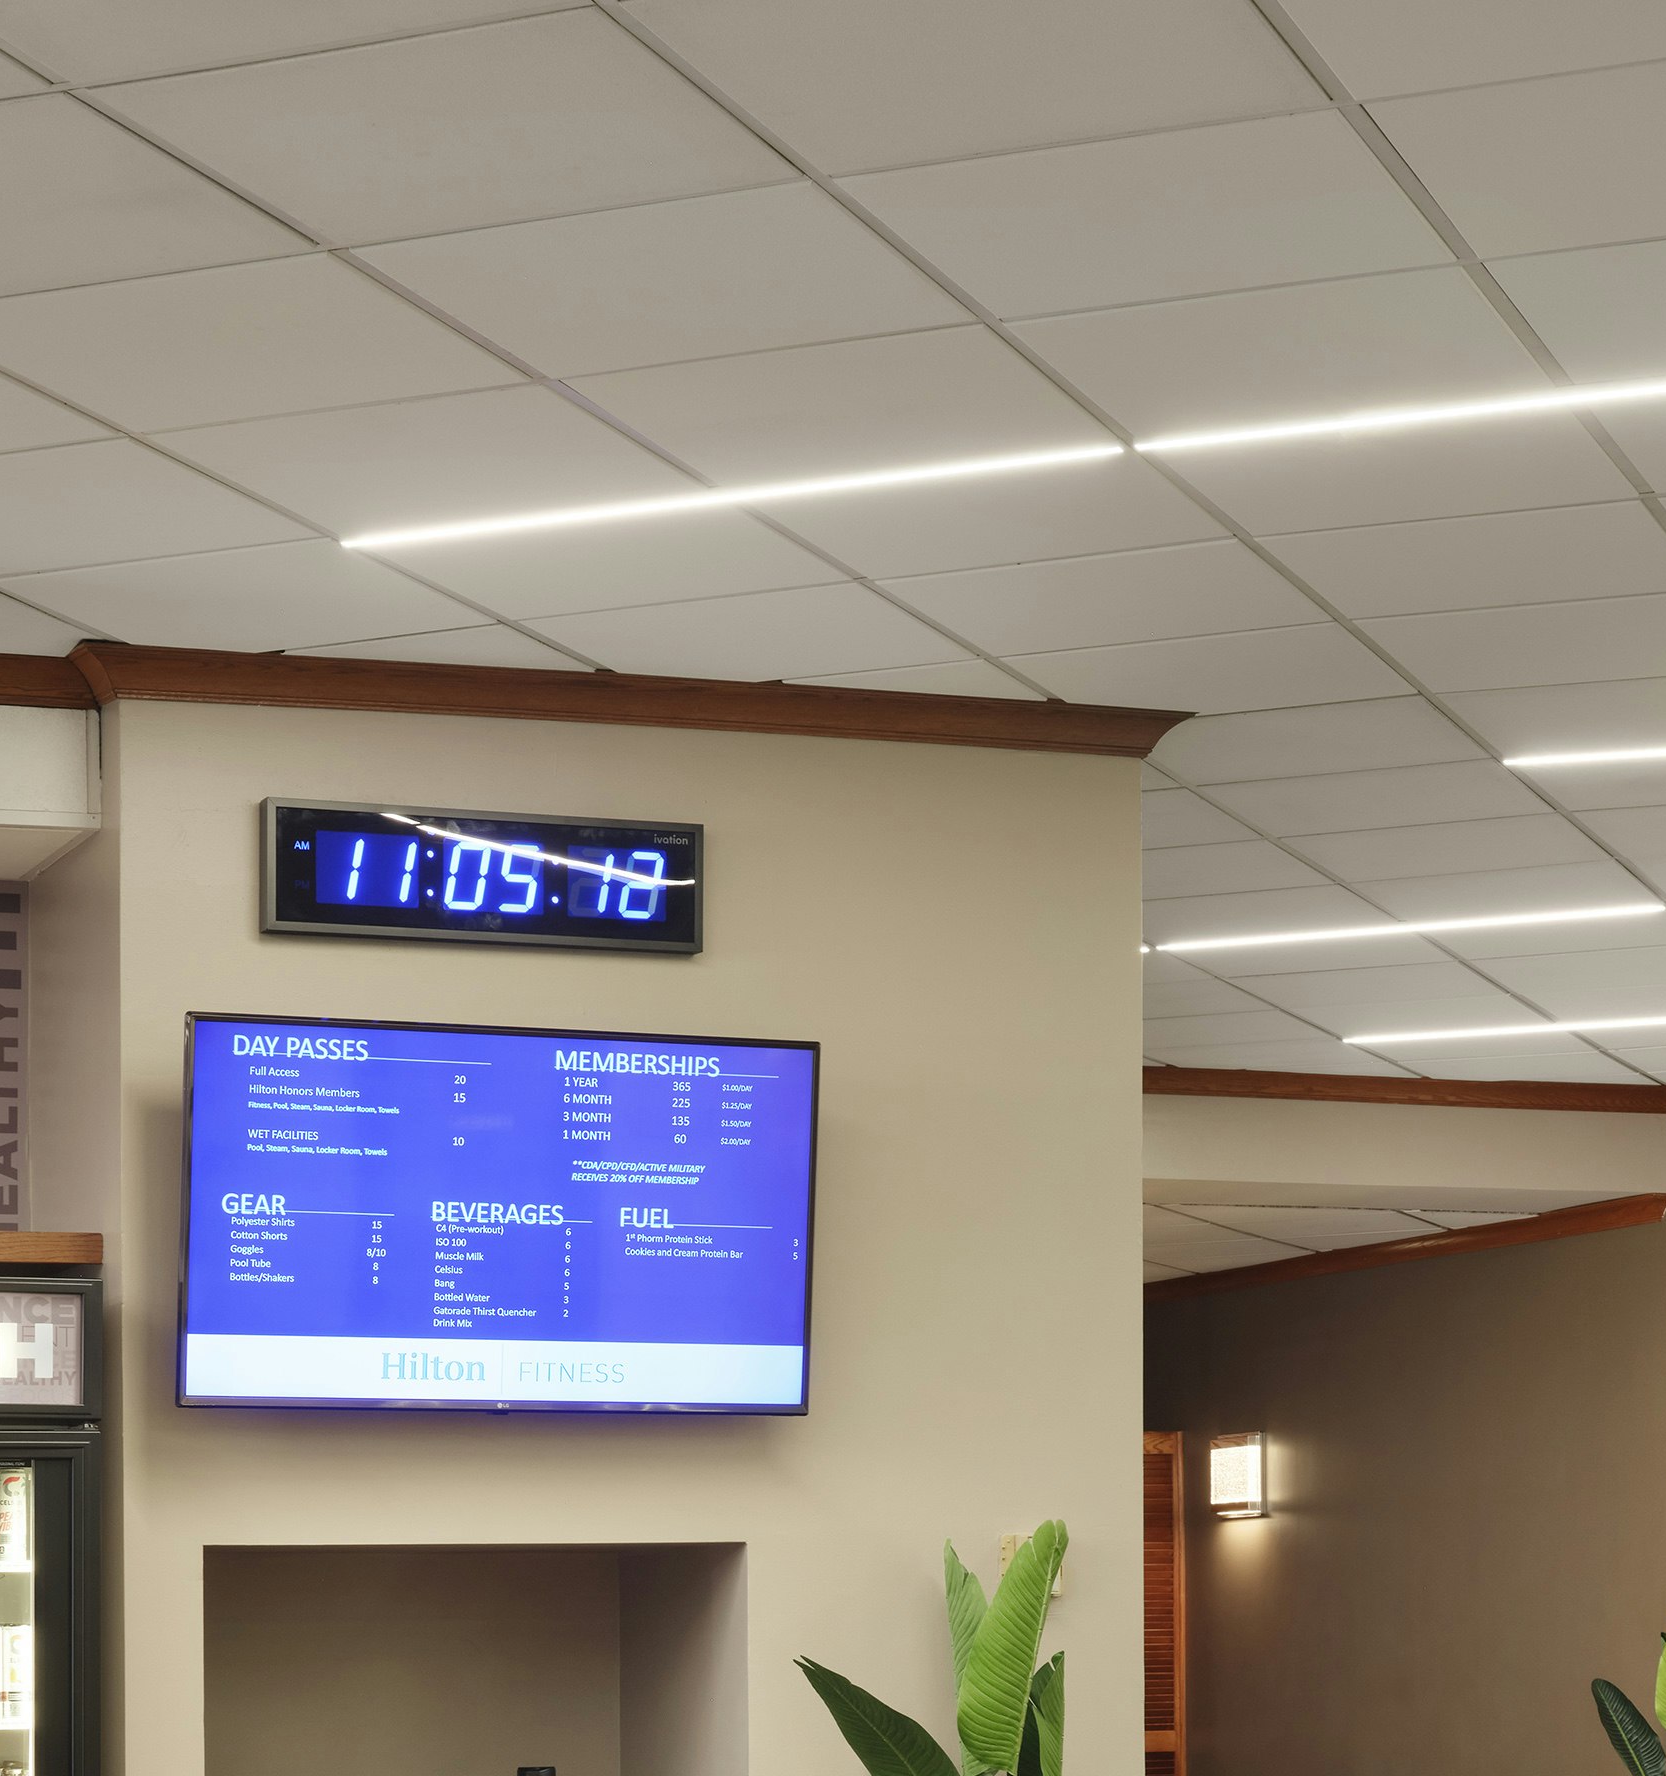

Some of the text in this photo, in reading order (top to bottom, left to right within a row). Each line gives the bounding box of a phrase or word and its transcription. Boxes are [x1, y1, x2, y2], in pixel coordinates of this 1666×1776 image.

[653, 834, 689, 846] ivation
[293, 840, 310, 851] AM
[233, 1035, 369, 1061] DAY PASSES
[555, 1050, 720, 1077] MEMBERSHIPS
[250, 1066, 299, 1077] Full Access
[454, 1075, 466, 1084] 20
[565, 1077, 598, 1087] 1 YEAR
[250, 1084, 360, 1098] Hilton Honors Members
[673, 1082, 691, 1091] 365
[454, 1093, 466, 1103] 15
[564, 1094, 611, 1104] 6 MONTH
[672, 1098, 690, 1108] 225
[274, 1102, 289, 1110] Pool,
[291, 1103, 312, 1111] Steam,
[313, 1104, 334, 1112] Sauna,
[563, 1112, 611, 1122] 3 MONTH
[672, 1116, 689, 1126] 135
[248, 1129, 318, 1140] WET FACILITIES
[563, 1130, 610, 1140] 1 MONTH
[674, 1134, 686, 1144] 60
[453, 1137, 464, 1146] 10
[247, 1144, 264, 1152] Pool,
[266, 1145, 290, 1153] Steam,
[292, 1146, 315, 1154] Sauna,
[340, 1147, 362, 1155] Room,
[668, 1165, 705, 1173] MILITARY
[572, 1173, 699, 1184] RECEIVES 20% OFF MEMBERSHIP
[221, 1193, 286, 1215] GEAR
[432, 1200, 564, 1226] BEVERAGES
[620, 1207, 674, 1229] FUEL
[232, 1217, 295, 1226] Polyester Shirts
[372, 1221, 382, 1229] 15
[436, 1224, 503, 1235] C4 (Pre-workout)
[566, 1228, 571, 1236] 6
[231, 1231, 287, 1240] Cotton Shorts
[372, 1235, 381, 1243] 15
[637, 1234, 663, 1242] Phorm
[665, 1235, 692, 1243] Protein
[695, 1236, 712, 1244] Stick
[436, 1238, 466, 1246] ISO 100
[230, 1245, 264, 1255] Goggles
[367, 1248, 386, 1258] 8/10
[625, 1247, 743, 1258] Cookies and Cream Protein Bar
[436, 1252, 483, 1260] Muscle Milk
[565, 1255, 570, 1263] 6
[793, 1252, 798, 1260] 5
[231, 1259, 271, 1267] Pool Tube
[373, 1262, 378, 1270] 8
[435, 1265, 463, 1274] Celsius
[230, 1273, 294, 1282] Bottles/Shakers
[373, 1276, 378, 1284] 8
[435, 1279, 455, 1289] Bang
[564, 1282, 569, 1290] 5
[434, 1293, 490, 1302] Bottled Water
[434, 1307, 536, 1316] Gatorade Thirst Quencher
[434, 1319, 472, 1327] Drink Mix
[381, 1352, 625, 1384] Hilton FITNESS
